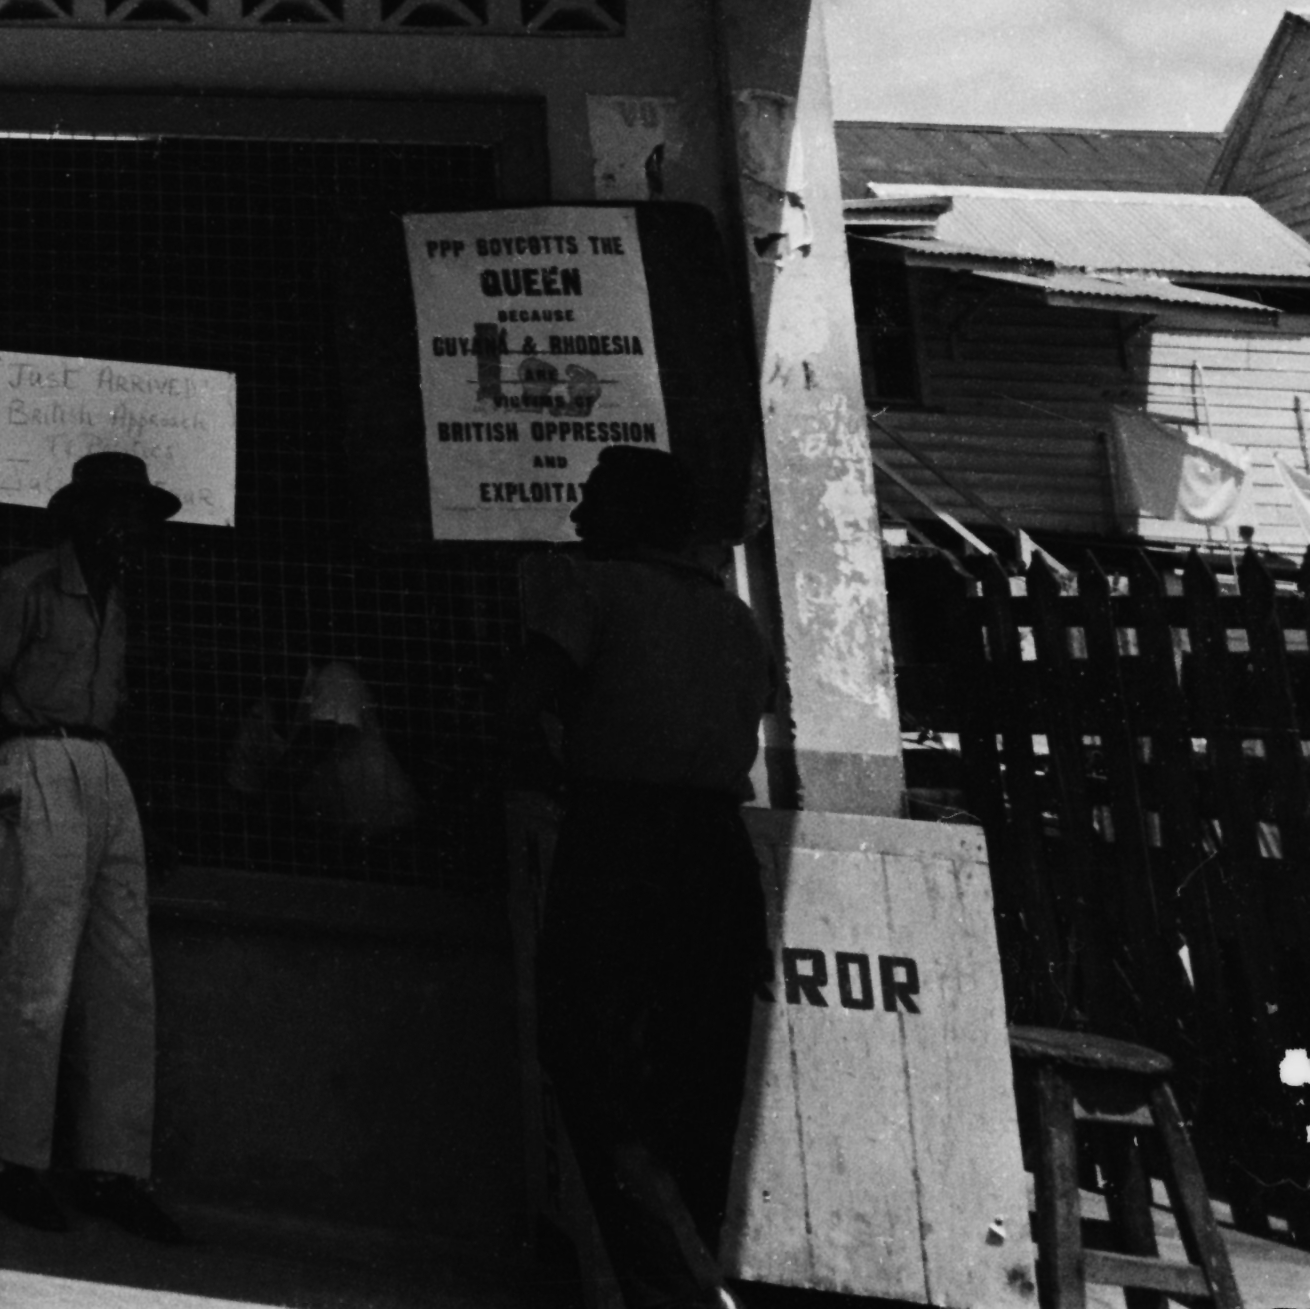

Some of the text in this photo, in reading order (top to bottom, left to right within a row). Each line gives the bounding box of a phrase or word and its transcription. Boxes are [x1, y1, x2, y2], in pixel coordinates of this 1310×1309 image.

[424, 234, 626, 259] PPP BOYCOTTS THE
[478, 266, 583, 297] QUEEN
[496, 309, 575, 323] BECAUSE
[522, 335, 540, 355] &
[548, 334, 644, 356] RHODESIA
[524, 367, 558, 382] ARE
[436, 420, 657, 443] BRITISH OPPRESSION
[532, 455, 569, 469] AND
